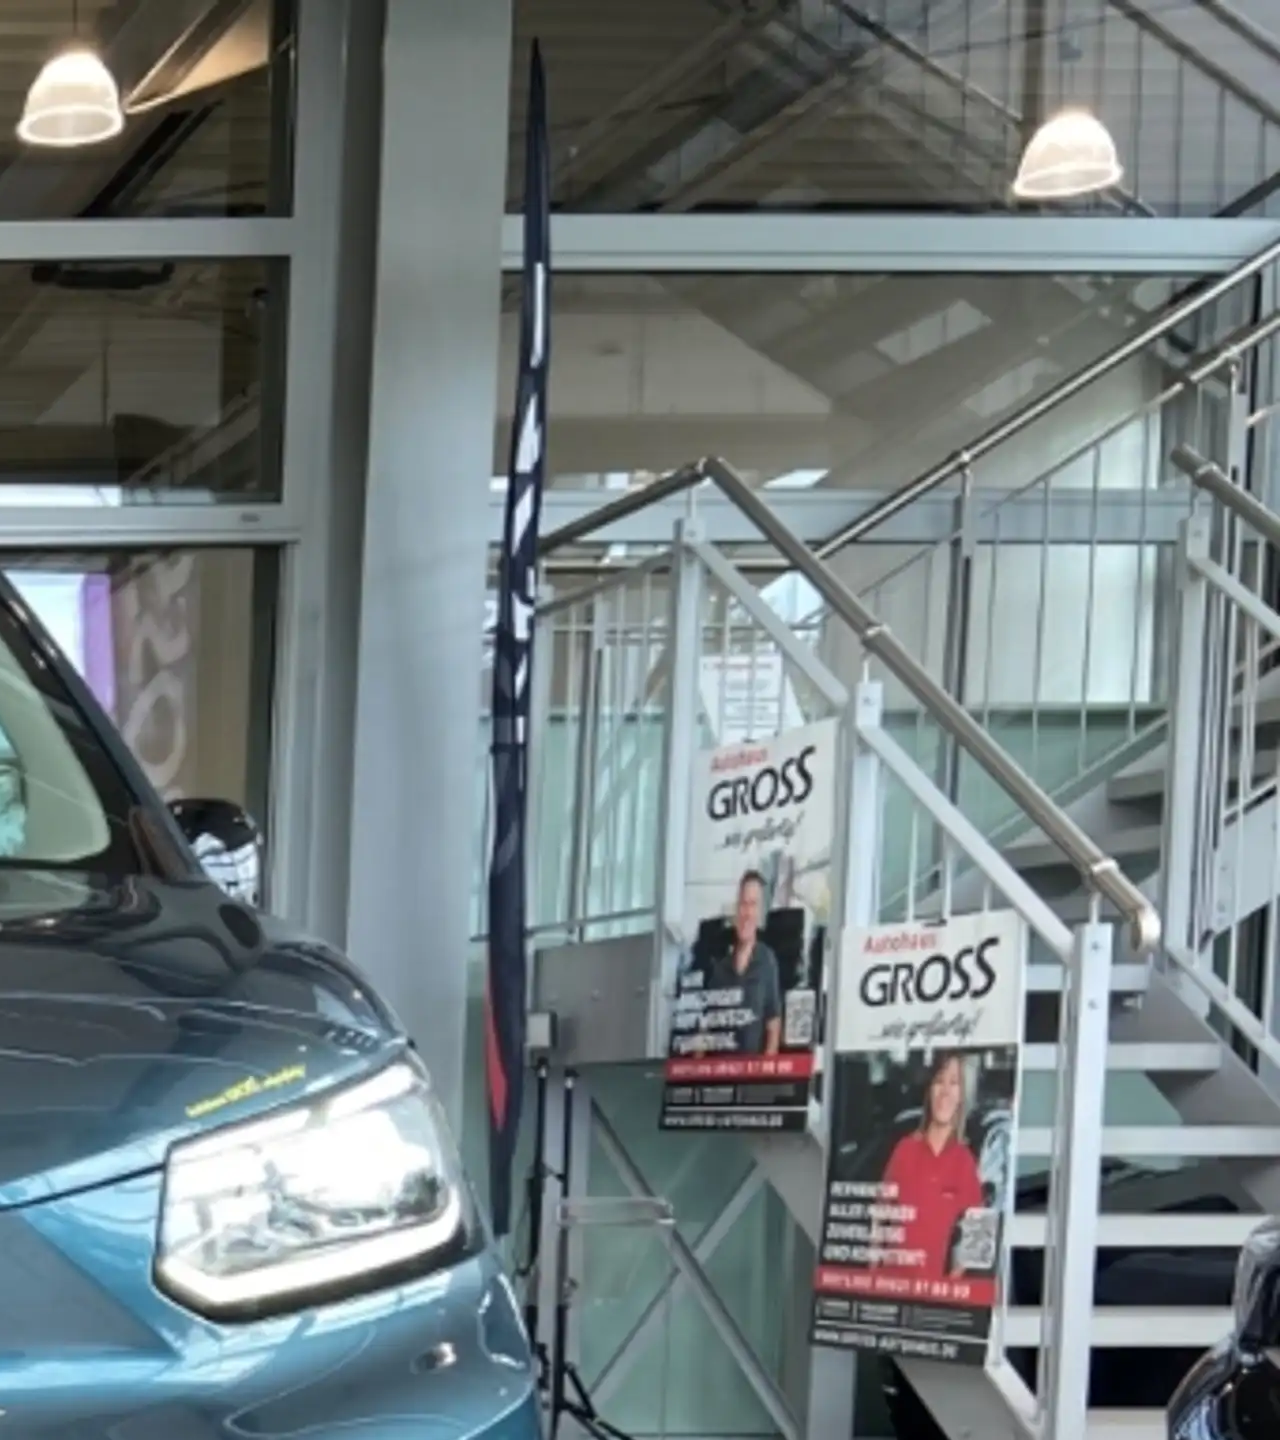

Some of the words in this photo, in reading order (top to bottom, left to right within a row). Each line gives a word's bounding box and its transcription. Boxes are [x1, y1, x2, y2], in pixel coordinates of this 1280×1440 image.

[707, 745, 816, 821] GROSS
[860, 936, 1000, 1007] GROSS
[863, 932, 937, 953] Autohaus
